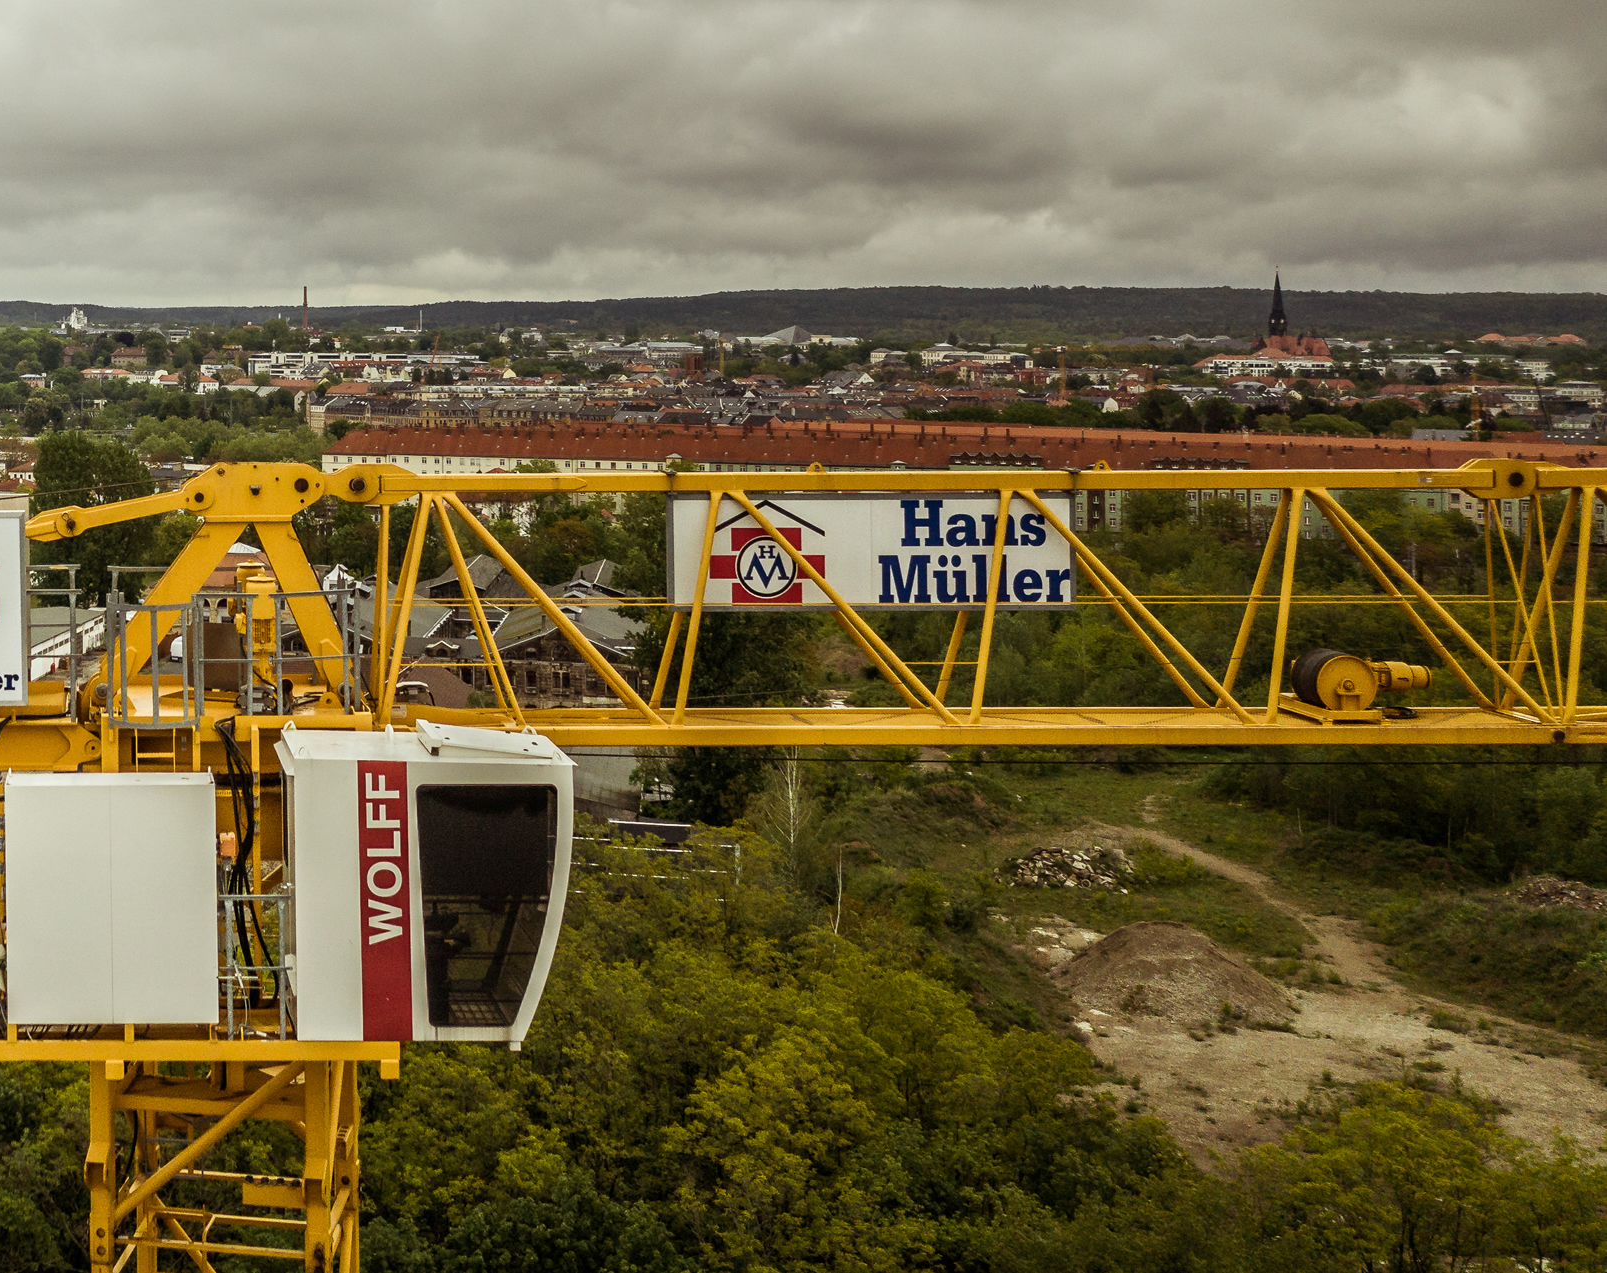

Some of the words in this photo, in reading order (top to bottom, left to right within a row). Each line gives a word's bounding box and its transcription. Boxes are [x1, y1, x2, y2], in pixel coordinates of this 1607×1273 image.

[900, 499, 1047, 547] Hans
[878, 554, 1071, 603] Müller
[364, 772, 404, 945] WOLFF
